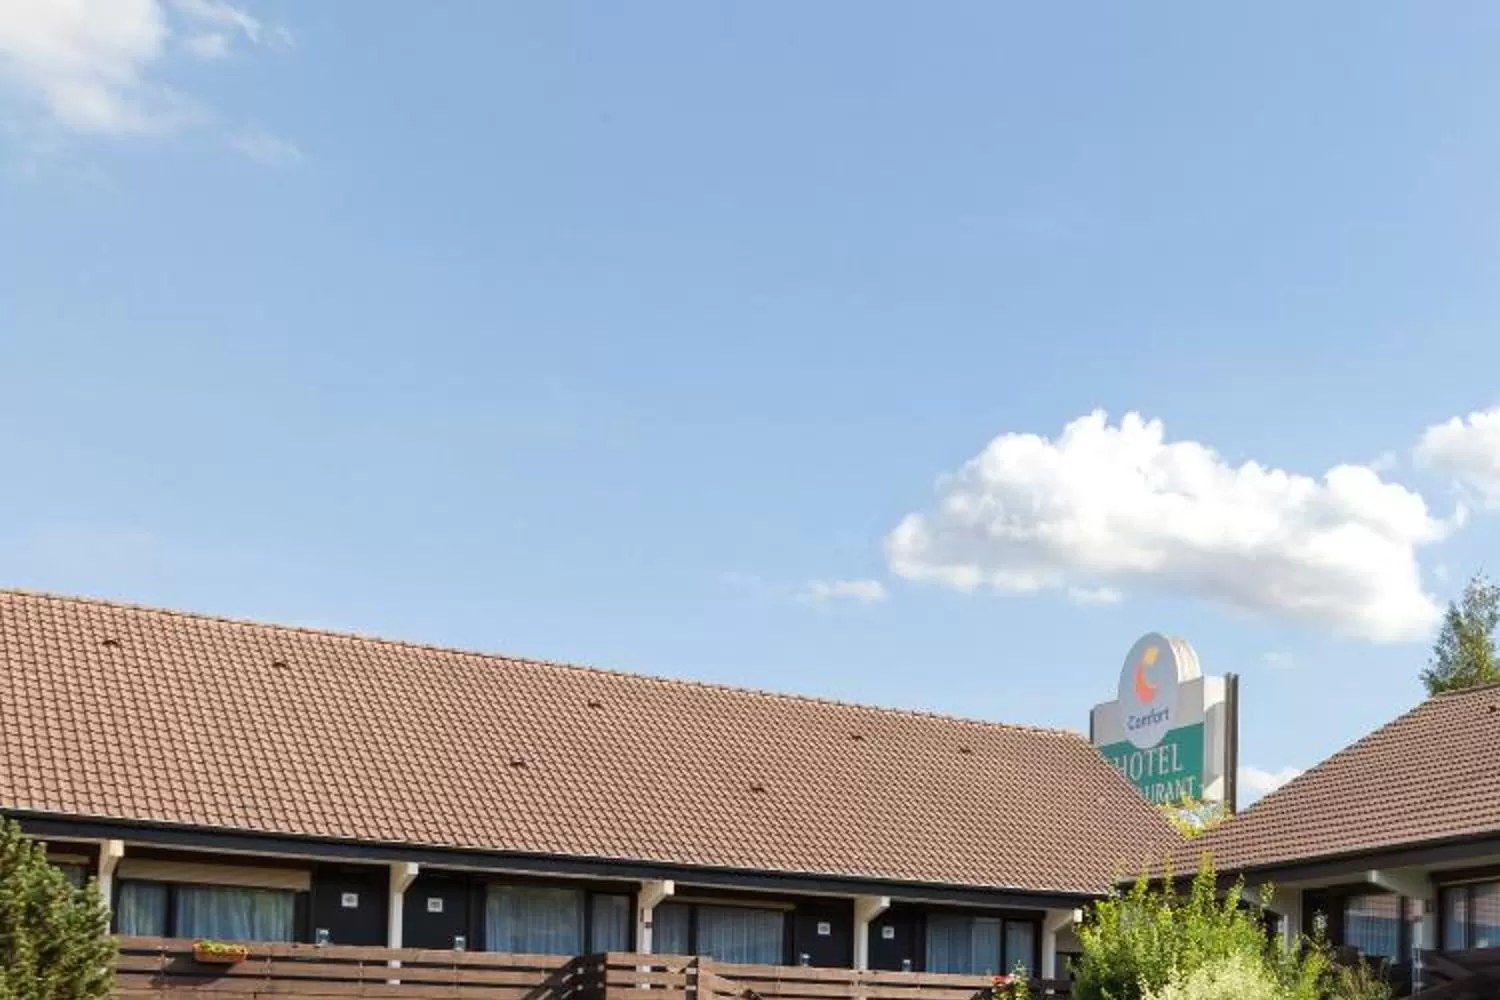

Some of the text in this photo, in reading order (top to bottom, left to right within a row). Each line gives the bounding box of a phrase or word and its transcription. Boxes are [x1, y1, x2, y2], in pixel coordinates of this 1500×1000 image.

[1127, 706, 1169, 730] Comfort
[1114, 743, 1183, 781] HOTEL
[1145, 777, 1196, 803] URANT
